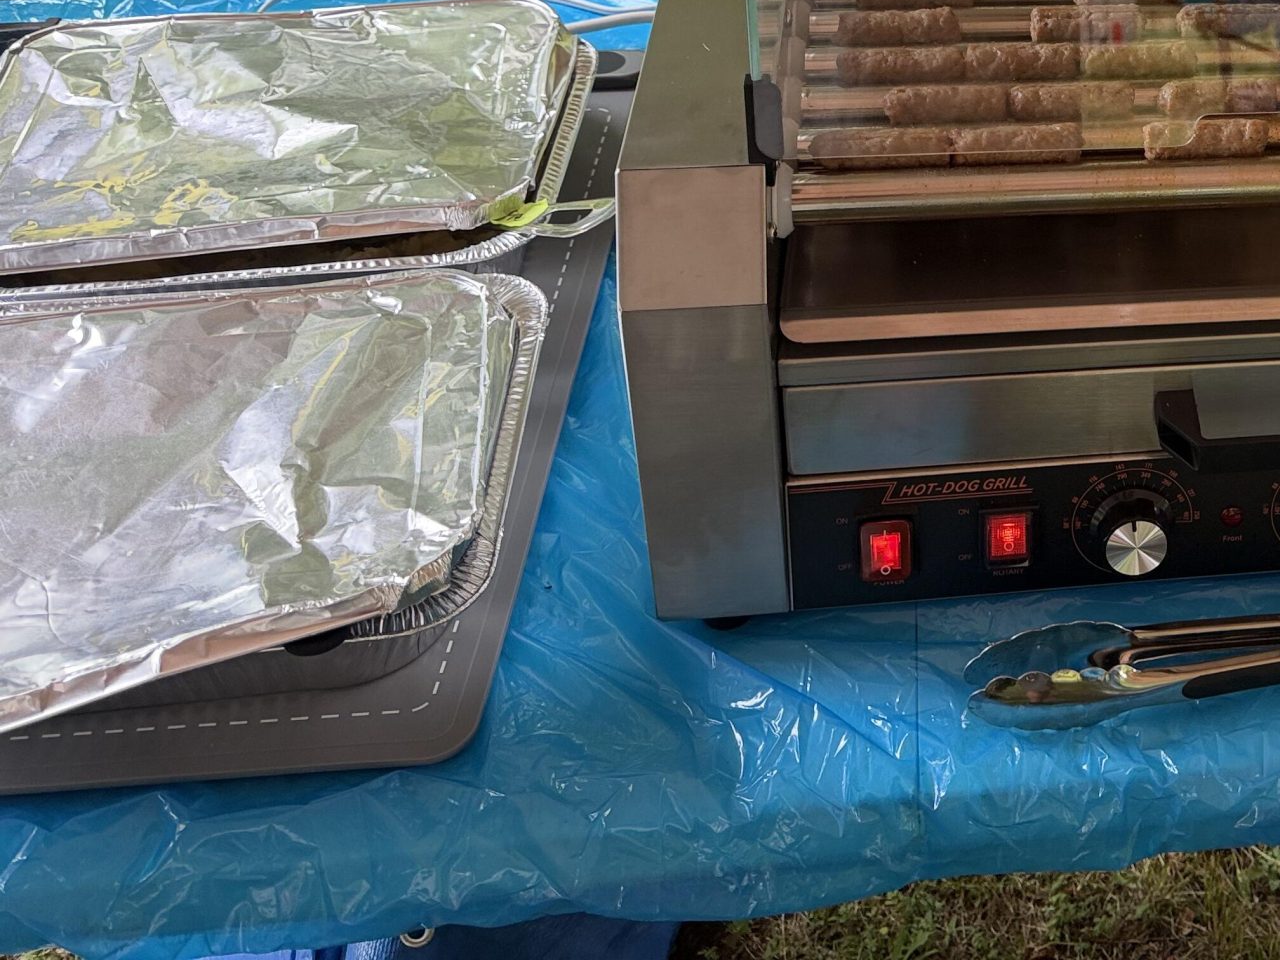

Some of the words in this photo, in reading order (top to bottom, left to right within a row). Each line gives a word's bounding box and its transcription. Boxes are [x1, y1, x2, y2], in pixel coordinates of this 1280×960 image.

[899, 480, 980, 498] HOT-DOG
[982, 476, 1028, 491] GRILL
[1222, 534, 1243, 543] Front
